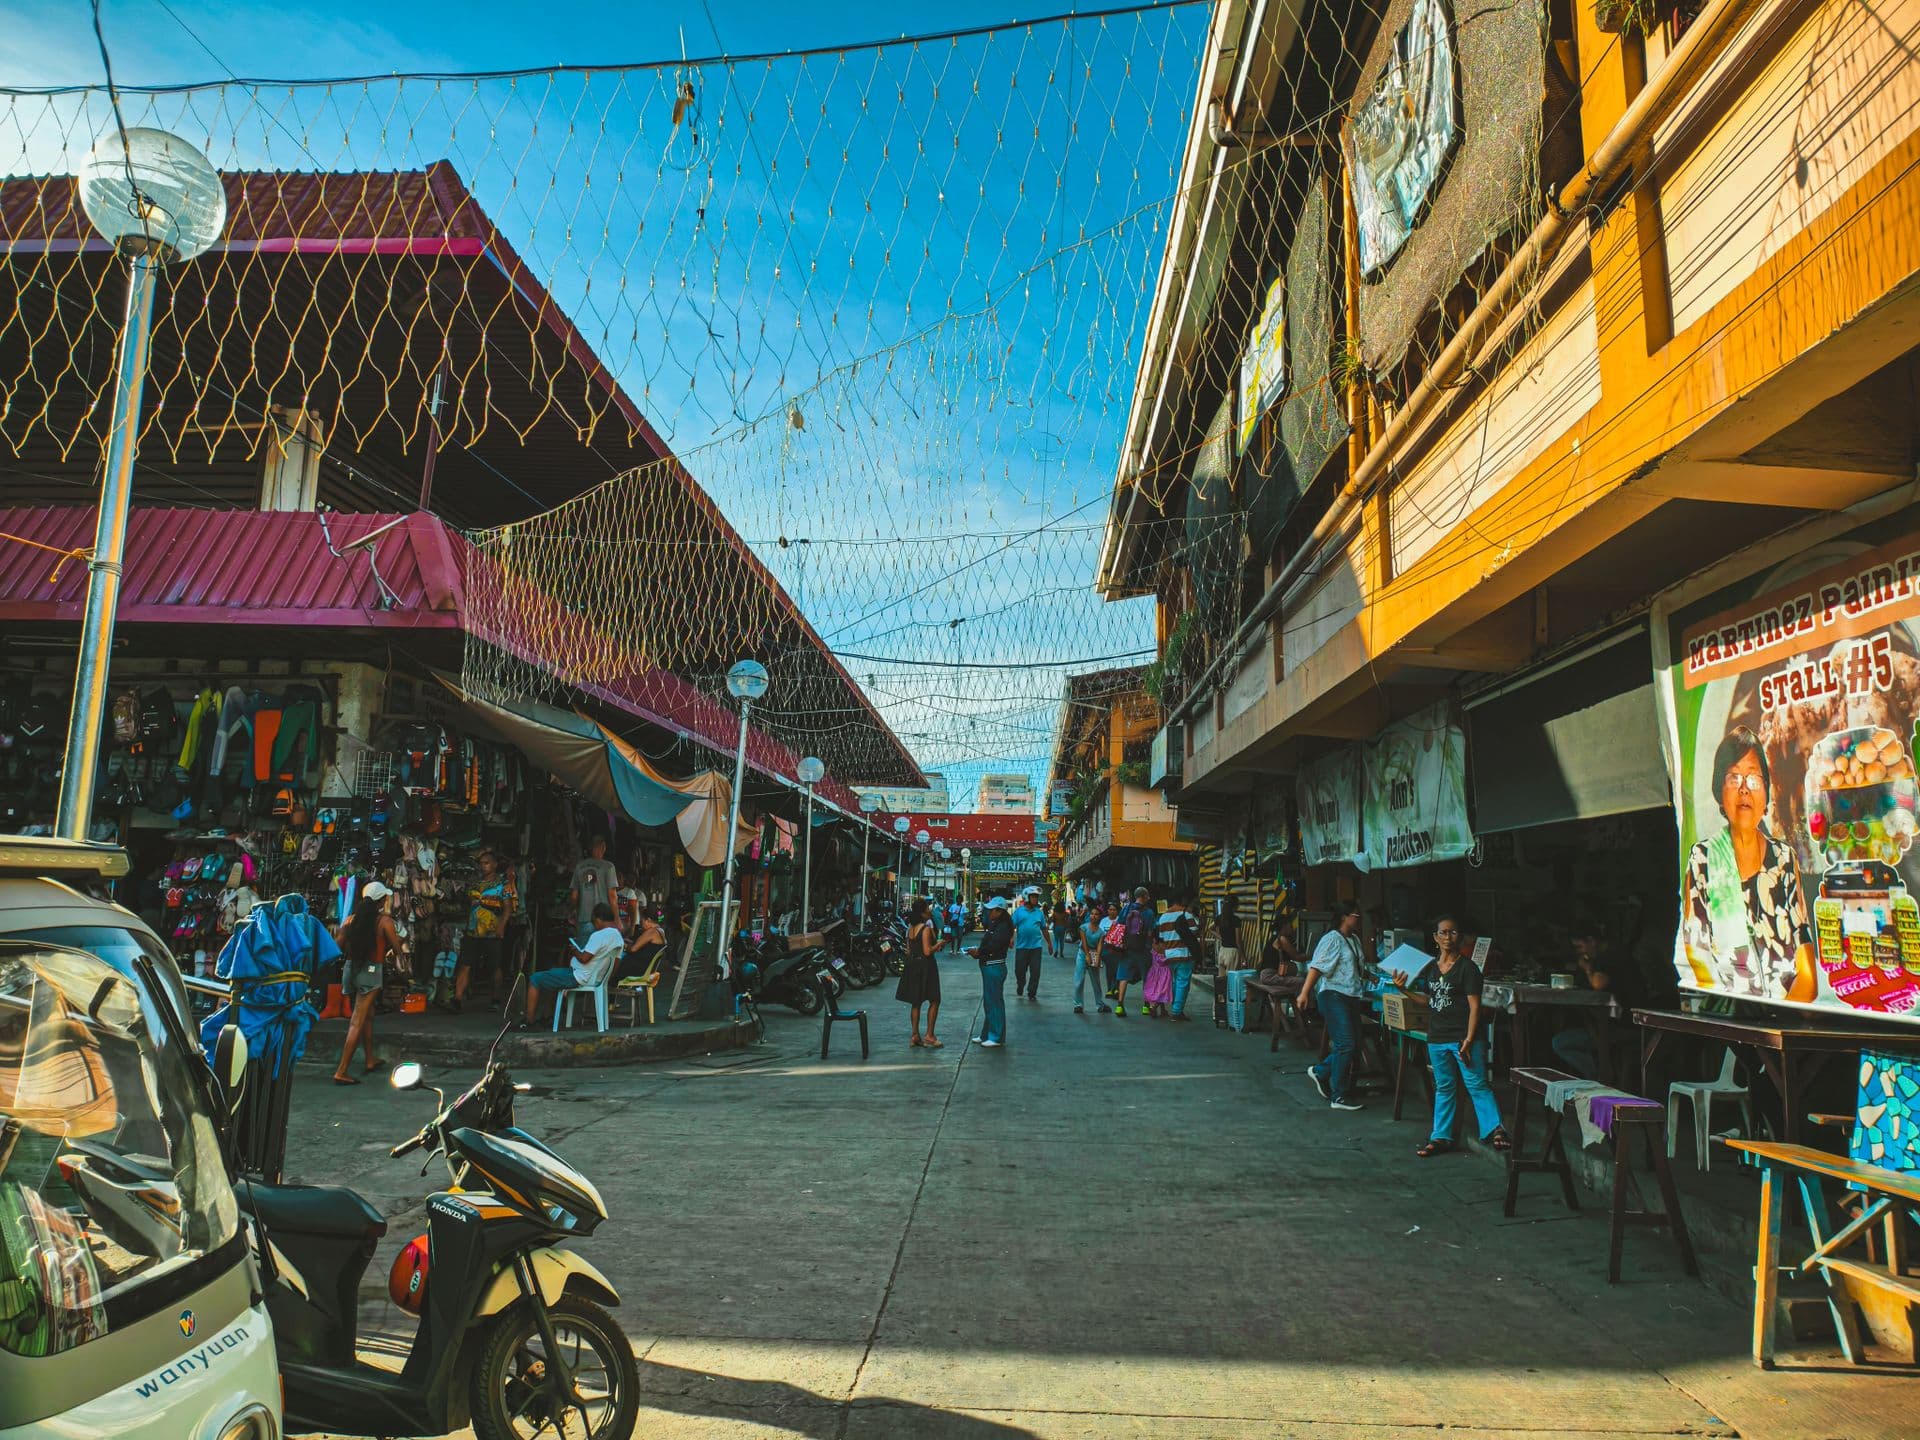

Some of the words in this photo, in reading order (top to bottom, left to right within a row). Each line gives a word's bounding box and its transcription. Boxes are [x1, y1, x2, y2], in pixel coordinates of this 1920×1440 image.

[989, 860, 1042, 871] PAINITAN
[431, 1201, 468, 1223] HONDA
[135, 1327, 250, 1399] wanyuan
